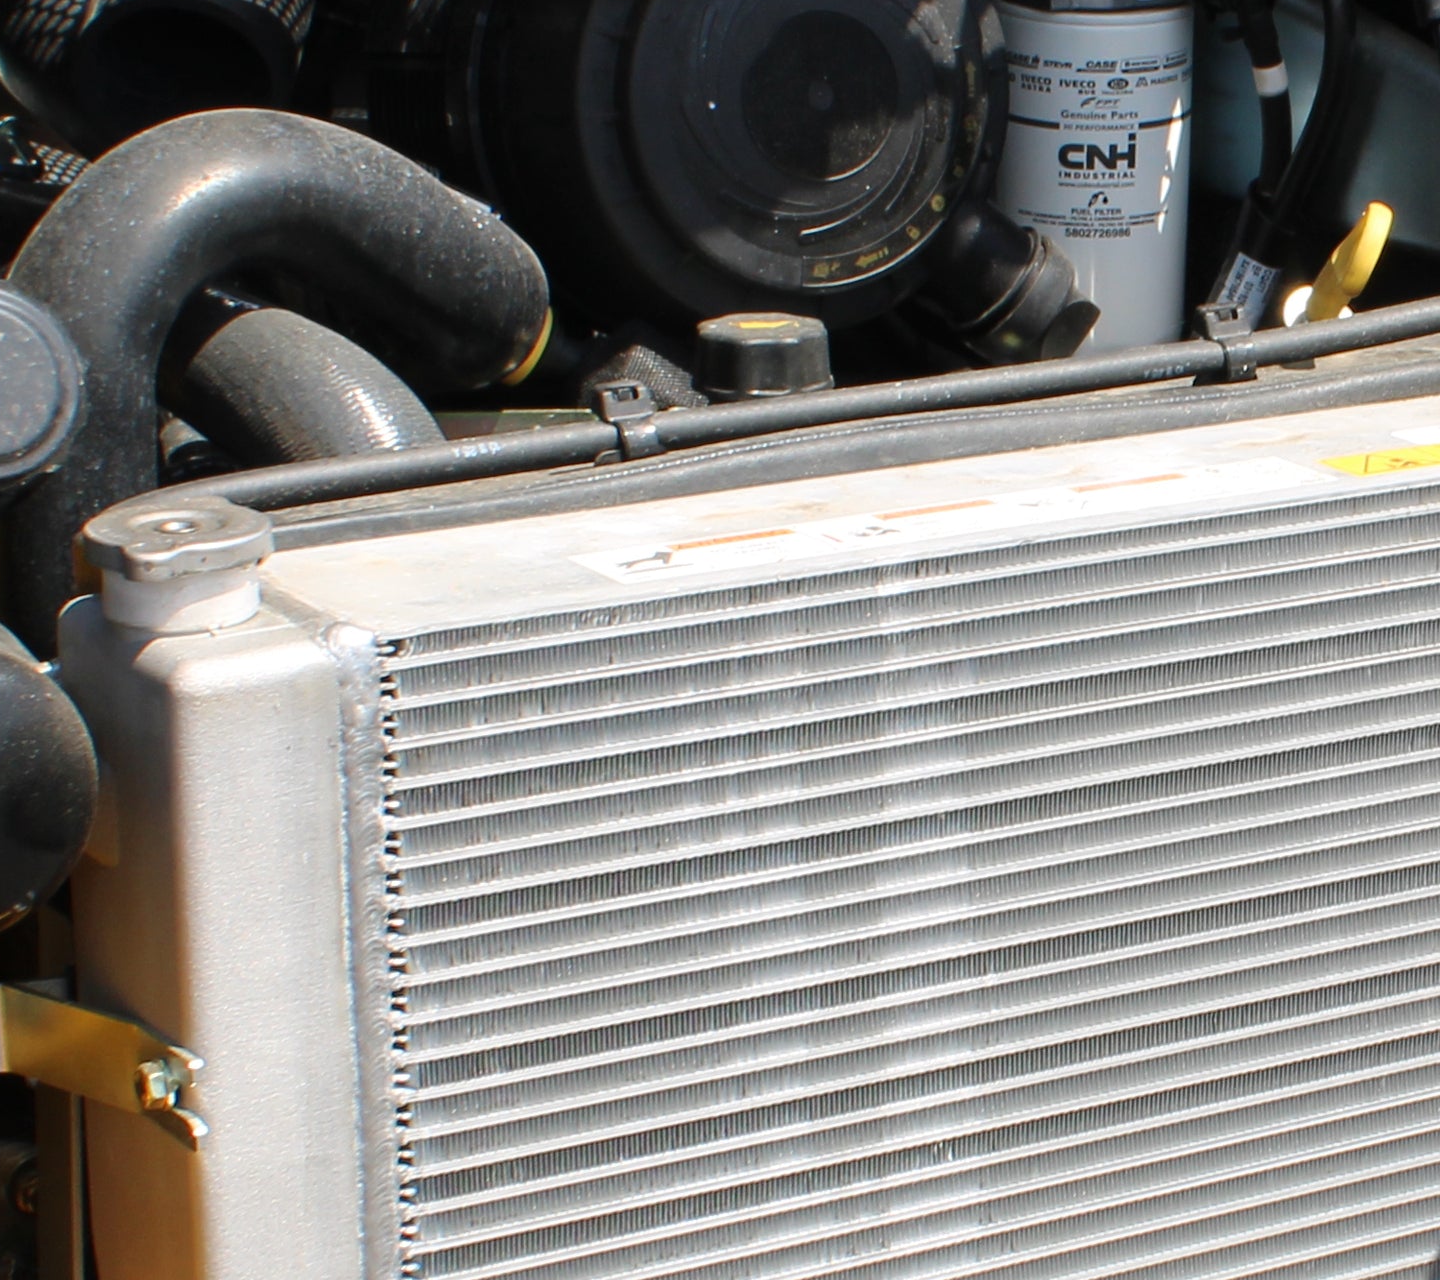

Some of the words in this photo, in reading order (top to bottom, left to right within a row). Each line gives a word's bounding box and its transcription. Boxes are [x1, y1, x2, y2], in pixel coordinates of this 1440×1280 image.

[1086, 60, 1118, 69] CASE
[1059, 79, 1096, 89] IVECO
[1060, 109, 1108, 120] Genuine
[1111, 109, 1139, 120] Parts
[1075, 123, 1135, 132] PERFORMANCE
[1058, 171, 1136, 180] INDUSTRIAL
